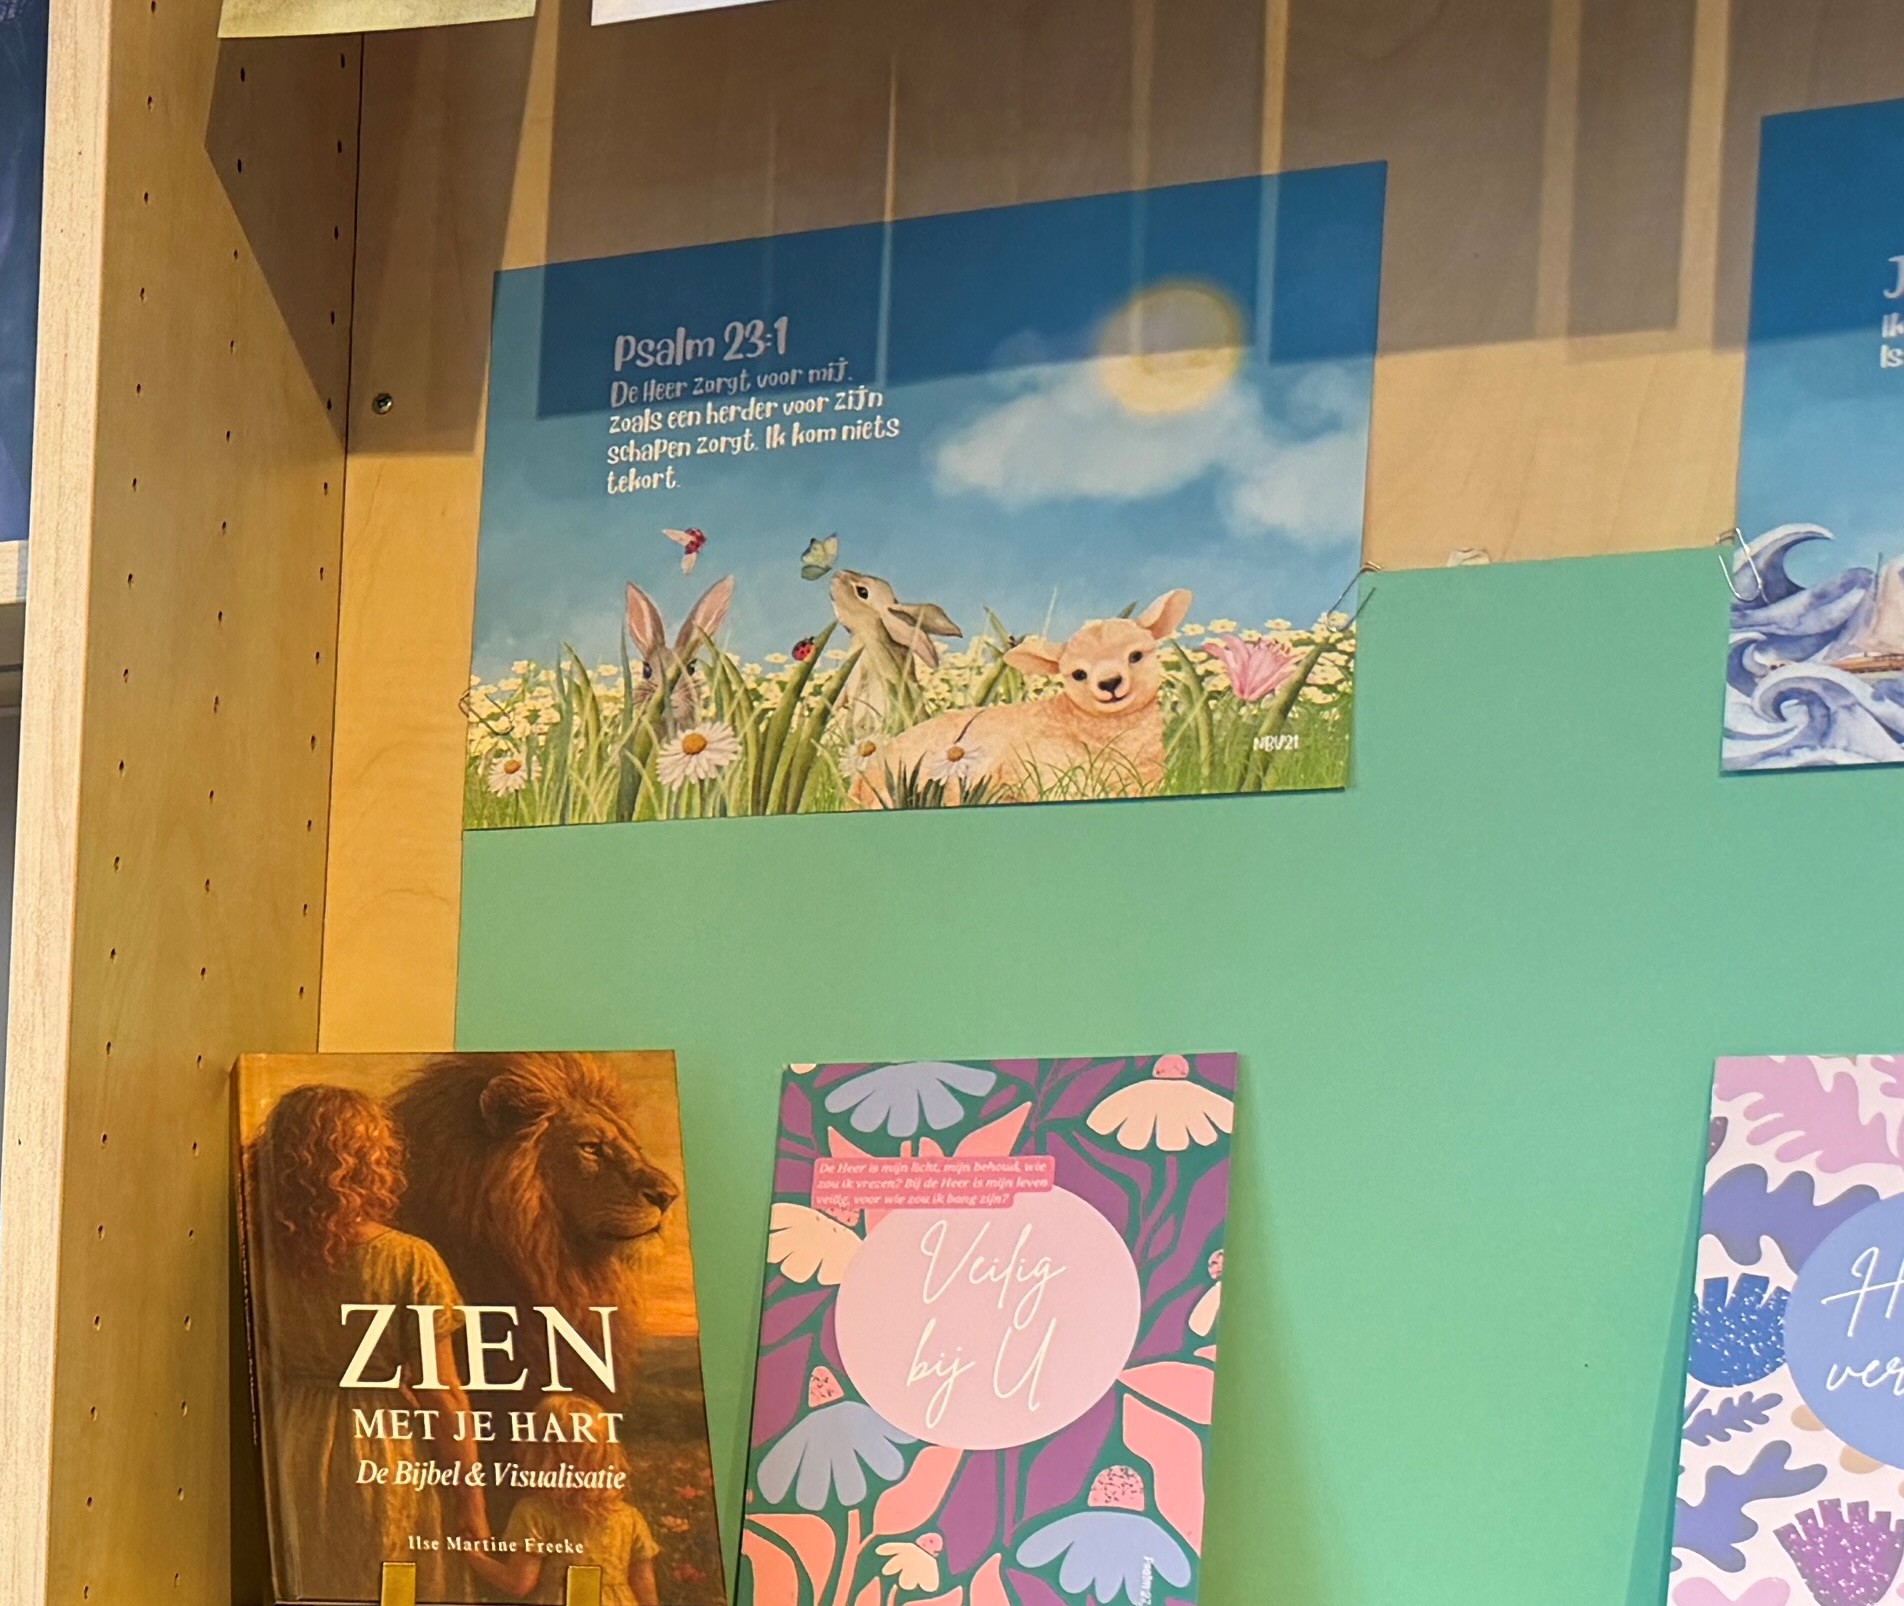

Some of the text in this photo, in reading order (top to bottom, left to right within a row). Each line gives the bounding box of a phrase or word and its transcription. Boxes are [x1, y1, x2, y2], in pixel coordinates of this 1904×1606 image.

[724, 316, 789, 361] 23:1
[611, 358, 853, 408] De Heer zorgt voor mij.
[609, 386, 883, 434] zoals een herder voor zijn
[697, 427, 758, 455] zorgt.
[766, 424, 785, 449] Ik
[792, 423, 836, 447] kom
[842, 415, 900, 441] niets
[607, 466, 680, 495] tekort.
[920, 1219, 1067, 1330] Veilig
[339, 1304, 618, 1394] ZIEN
[906, 1316, 1057, 1426] bij U
[352, 1408, 623, 1444] MET JE HART
[356, 1459, 627, 1492] De Bijbel & Visualisatie
[408, 1535, 584, 1555] Ilse Martine Freeke
